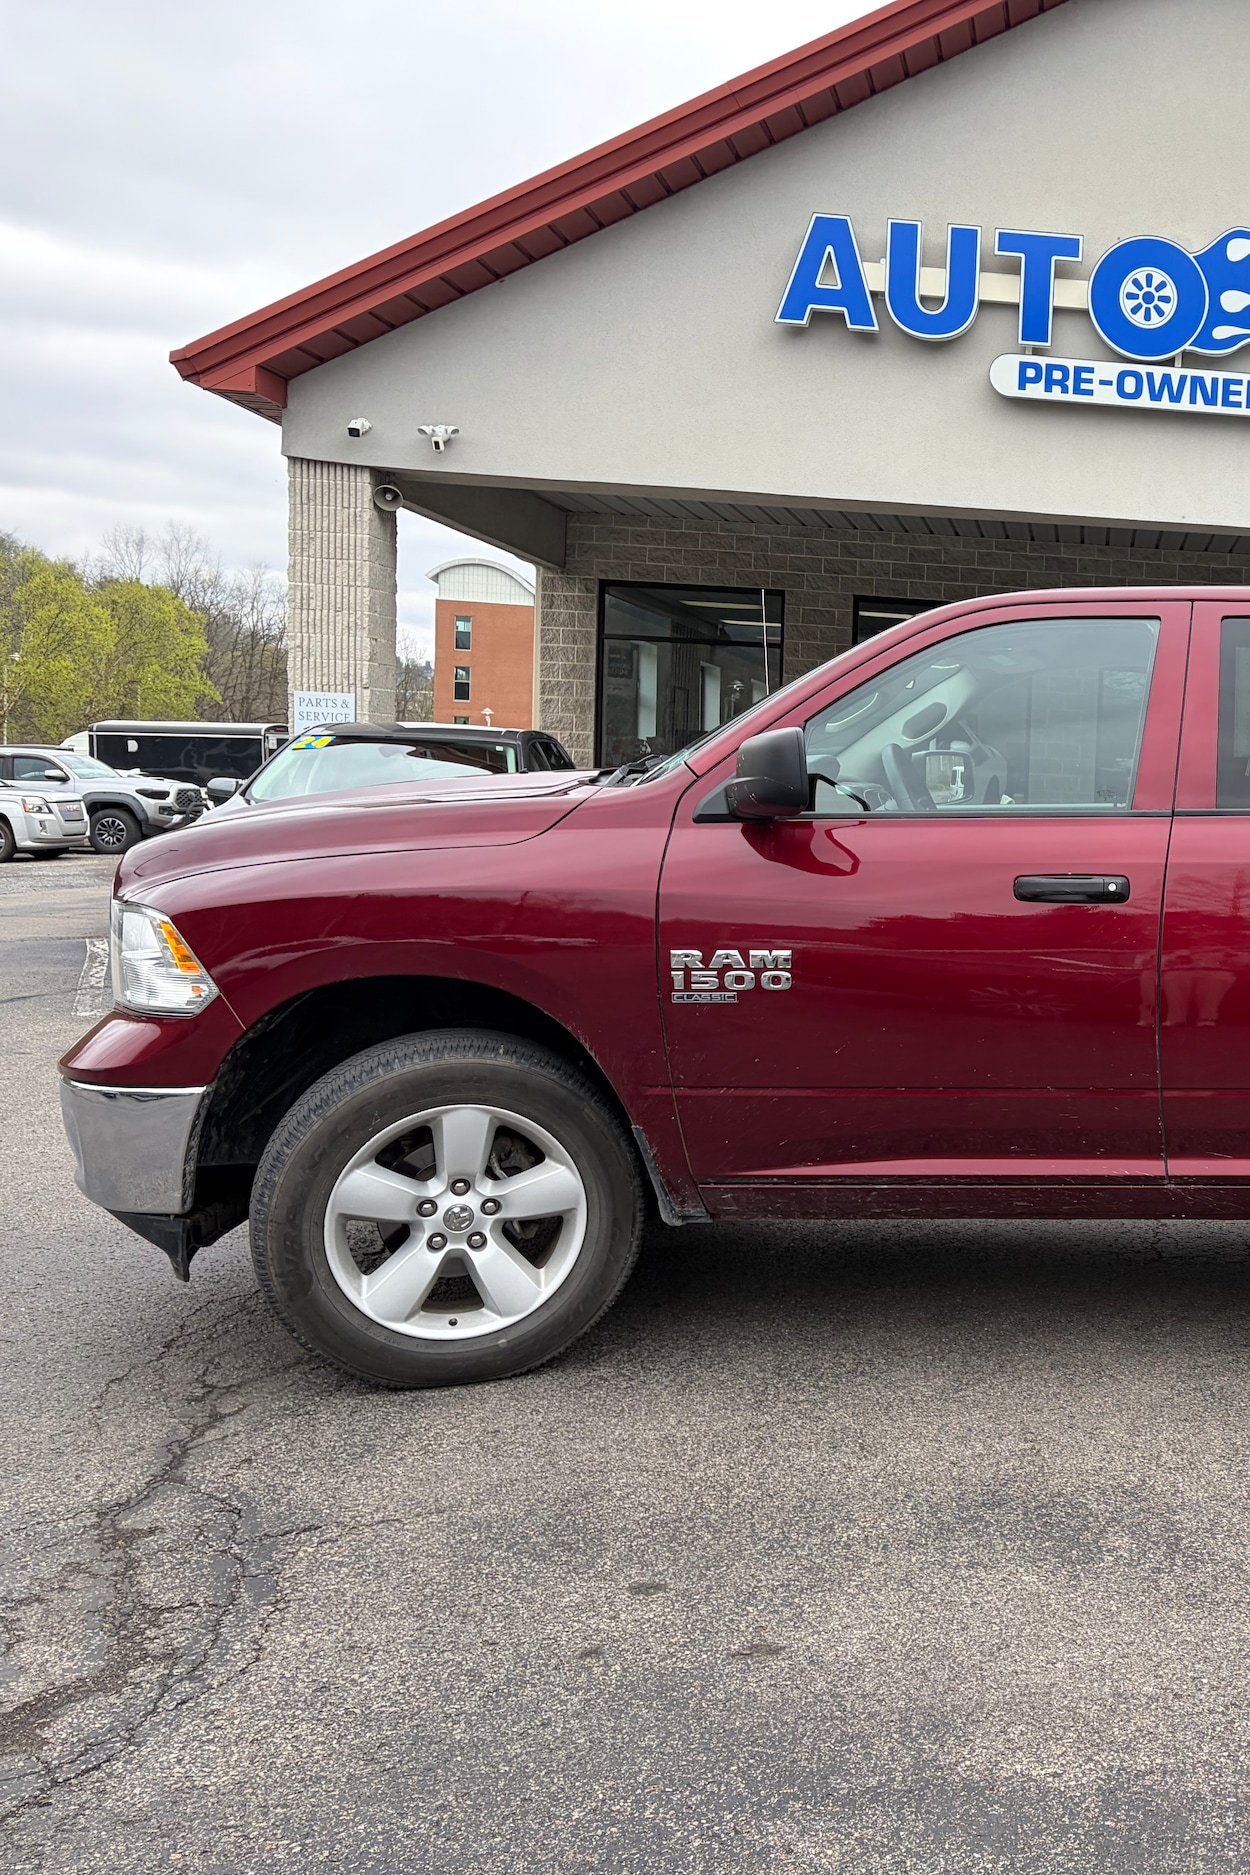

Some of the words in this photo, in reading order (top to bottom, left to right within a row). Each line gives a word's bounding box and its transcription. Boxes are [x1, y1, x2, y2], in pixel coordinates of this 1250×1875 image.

[774, 211, 1208, 362] AUTO
[298, 696, 338, 709] PARTS
[340, 698, 350, 709] &
[298, 711, 351, 723] SERVICE
[670, 949, 793, 969] RAM
[670, 970, 793, 991] 1500
[672, 993, 736, 1002] CLASSIC
